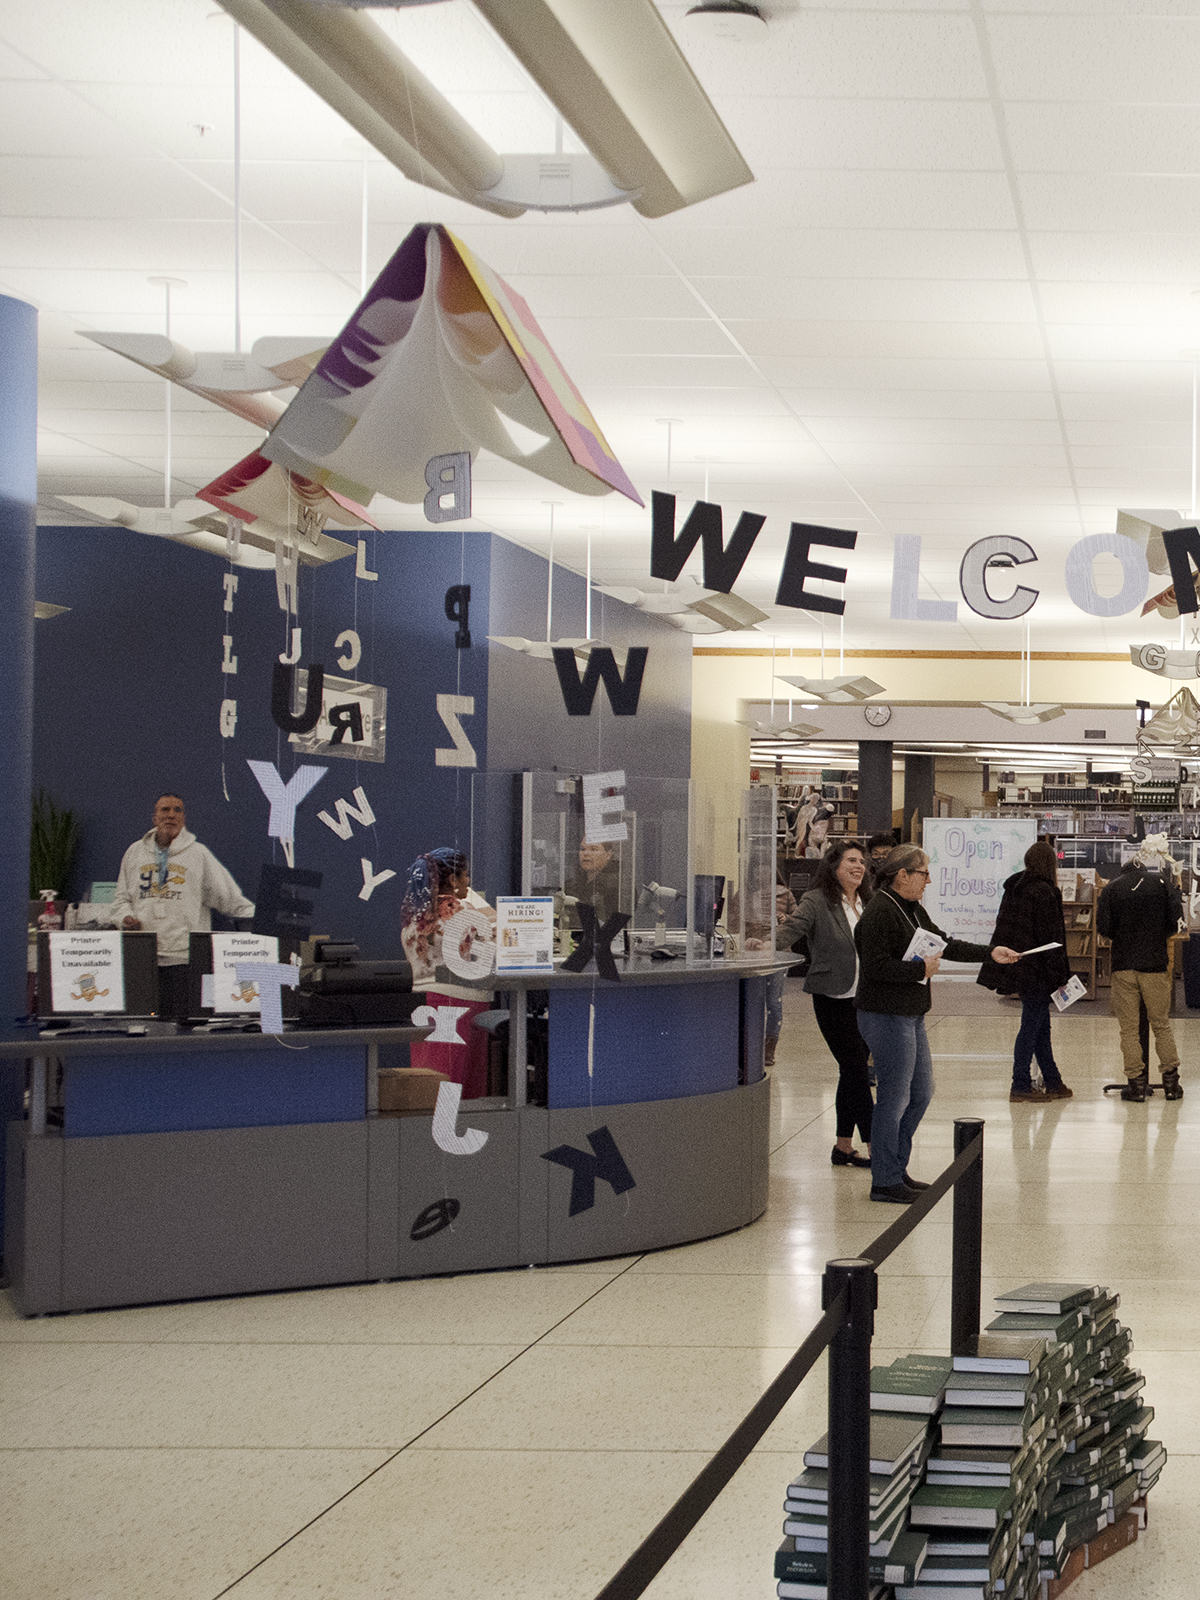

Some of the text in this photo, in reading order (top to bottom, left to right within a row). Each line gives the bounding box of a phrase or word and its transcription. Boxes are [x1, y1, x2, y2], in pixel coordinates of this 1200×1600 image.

[553, 647, 648, 715] W
[246, 760, 328, 838] Y
[317, 786, 376, 840] W
[582, 770, 628, 844] E
[945, 827, 1002, 868] Open
[358, 857, 396, 900] Y
[60, 948, 112, 957] Temporarily
[235, 961, 299, 1034] T
